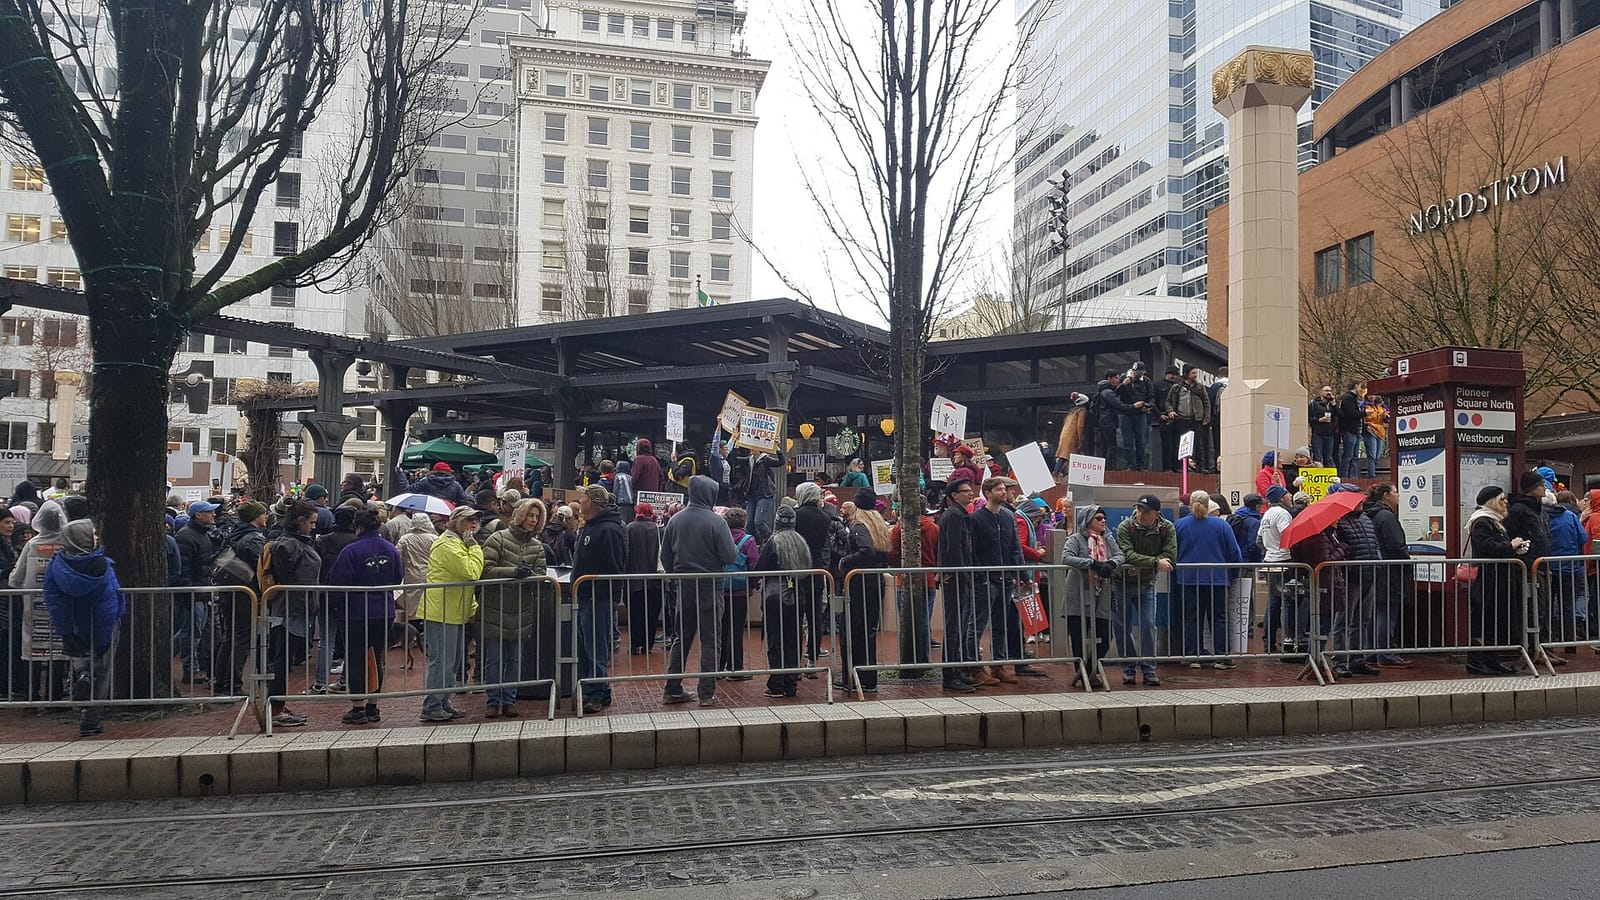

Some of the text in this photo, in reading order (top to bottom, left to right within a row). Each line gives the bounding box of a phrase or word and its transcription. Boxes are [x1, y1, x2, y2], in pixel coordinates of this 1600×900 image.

[1410, 155, 1566, 236] NORDSTROM
[1456, 387, 1490, 398] Pioneer
[1397, 393, 1424, 404] Pioneer
[1456, 398, 1514, 409] Square North
[1397, 400, 1444, 415] Square North
[1398, 434, 1436, 447] Westbound
[1457, 432, 1504, 444] Westbound
[797, 454, 823, 467] UNITY
[1072, 461, 1103, 471] ENOUGH
[1401, 458, 1417, 467] MAX
[1460, 457, 1479, 466] MAX
[1301, 471, 1335, 483] PROTEC
[1300, 484, 1321, 495] KIDS
